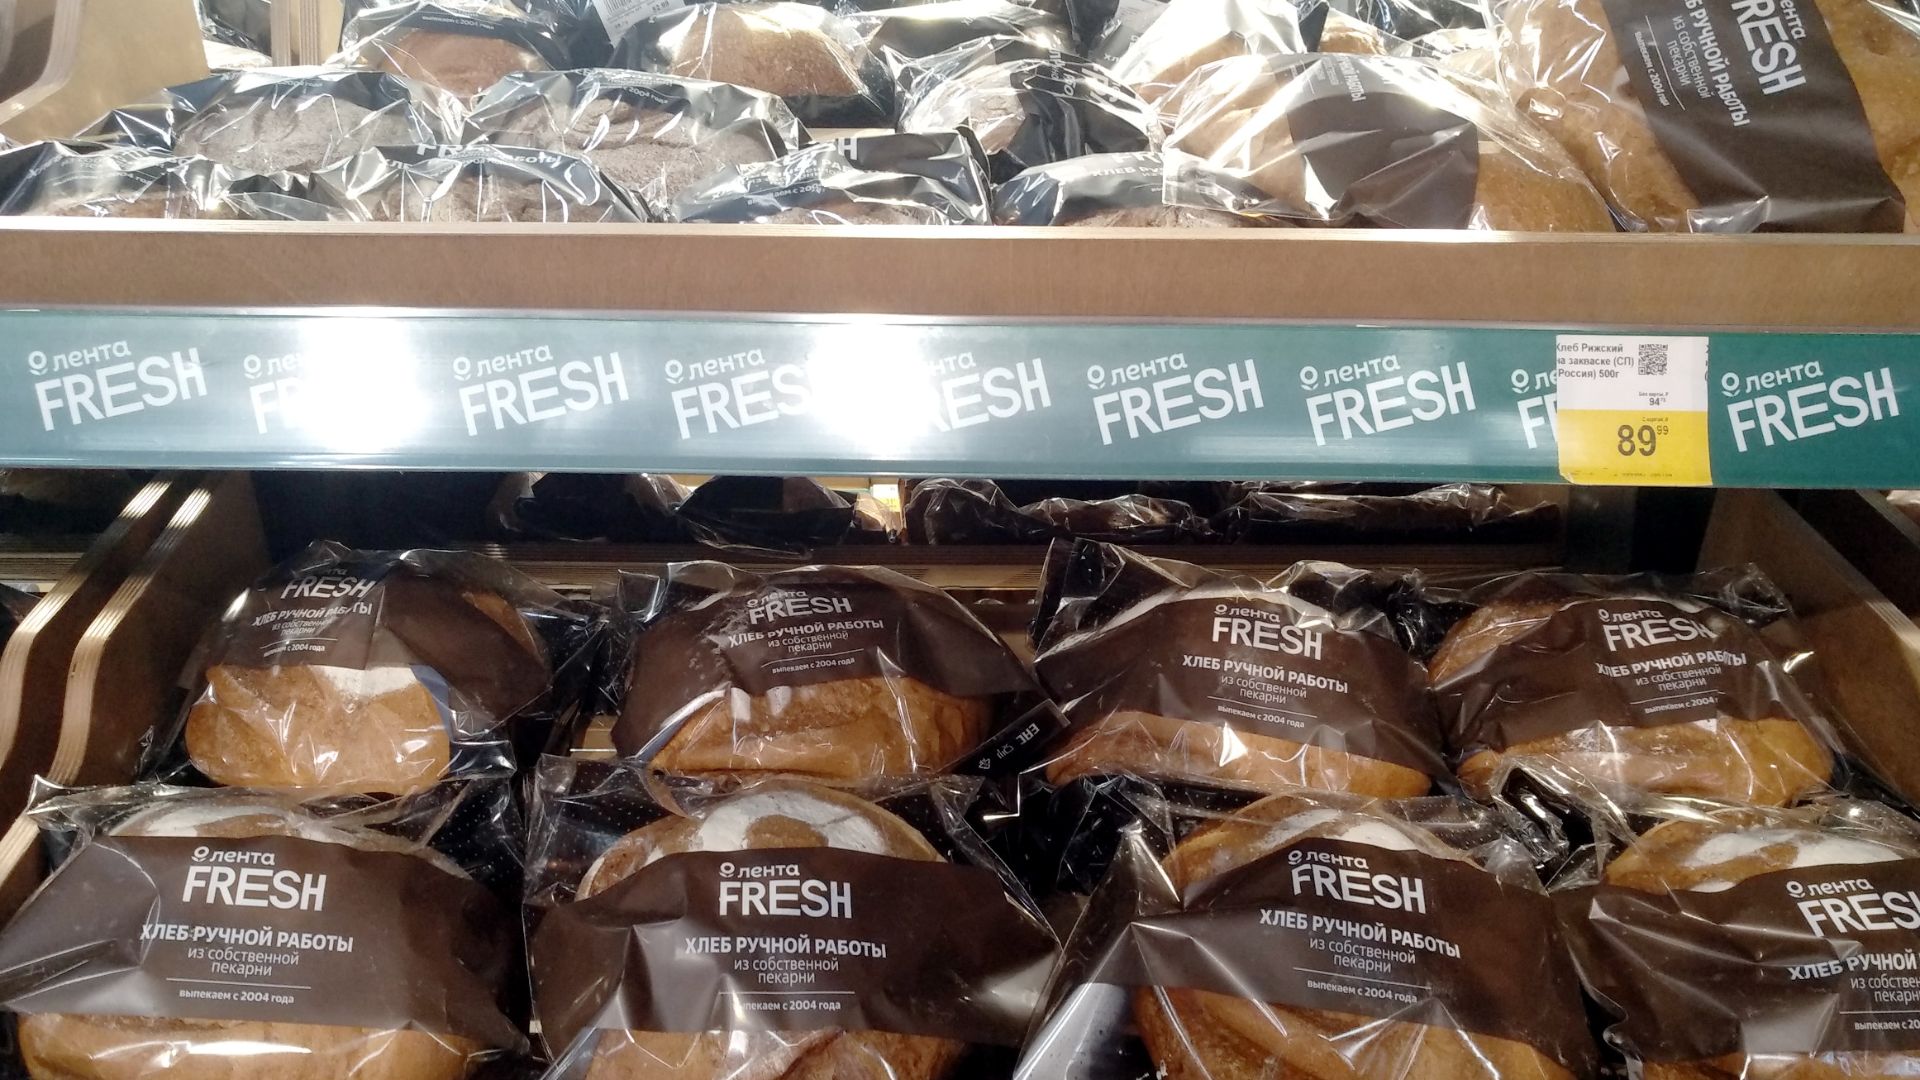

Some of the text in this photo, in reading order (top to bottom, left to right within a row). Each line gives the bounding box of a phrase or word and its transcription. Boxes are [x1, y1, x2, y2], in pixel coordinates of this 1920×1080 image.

[1672, 15, 1686, 31] из
[1780, 0, 1806, 40] ента
[1731, 0, 1806, 95] RESH
[1667, 40, 1692, 87] пекарни
[1678, 30, 1715, 99] собственной
[1690, 8, 1750, 127] РУЧНОЙ РАБОТЫ
[1650, 72, 1664, 95] 2004
[53, 339, 132, 371] лента
[1582, 343, 1623, 353] Рижский
[477, 344, 554, 377] лента
[687, 348, 766, 381] лента
[1112, 352, 1188, 386] лента
[1323, 354, 1401, 387] лента
[1568, 358, 1611, 366] закваске
[1613, 356, 1634, 367] (СП)
[1599, 369, 1619, 379] 500г
[1746, 361, 1823, 392] лента
[34, 347, 208, 431] FRESH
[458, 351, 630, 436] FRESH
[671, 361, 812, 440] FRES
[1093, 358, 1264, 445] FRESH
[1307, 361, 1476, 446] FRESH
[1649, 397, 1660, 406] 94
[1726, 367, 1900, 453] FRESH
[1617, 424, 1669, 456] 89 99
[280, 576, 376, 599] FRESH
[251, 611, 279, 626] ХЛЕБ
[277, 606, 326, 621] РУЧНОЙ
[749, 597, 852, 625] FRESH
[1229, 606, 1281, 623] лента
[1612, 609, 1664, 623] лента
[728, 619, 884, 648] ХЛЕБ РУЧНОЙ РАБОТЫ
[768, 631, 849, 648] из собственной
[1212, 617, 1323, 660] FRESH
[291, 644, 309, 652] 2004
[309, 644, 326, 653] года
[788, 641, 832, 653] пекарни
[772, 664, 809, 674] выпекаем
[816, 659, 837, 668] 2004
[838, 657, 855, 667] года
[1182, 654, 1349, 694] ХЛЕБ РУЧНОЙ РАБОТЫ
[1595, 662, 1630, 678] ХЛЕБ
[1631, 652, 1695, 674] РУЧНОЙ
[1636, 665, 1722, 686] из собственной
[1221, 675, 1307, 698] из собственной
[1239, 688, 1287, 704] пекарни
[1658, 677, 1707, 692] пекарни
[1692, 697, 1715, 707] 2004
[1217, 705, 1256, 720] выпекаем
[1263, 713, 1286, 725] 2004
[1286, 719, 1305, 729] года
[210, 850, 276, 866] лента
[1305, 849, 1369, 870] лента
[737, 863, 800, 878] лента
[182, 865, 327, 911] FRESH
[1291, 864, 1426, 914] FRESH
[1807, 878, 1874, 896] лента
[719, 879, 853, 919] FRESH
[140, 923, 354, 953] ХЛЕБ РУЧНОЙ РАБОТЫ
[1259, 908, 1461, 959] ХЛЕБ РУЧНОЙ РАБОТЫ
[187, 946, 300, 966] из собственной
[685, 934, 888, 959] ХЛЕБ РУЧНОЙ РАБОТЫ
[1309, 938, 1416, 965] из собственной
[211, 960, 273, 978] пекарни
[734, 956, 839, 971] из собственной
[1333, 954, 1392, 974] пекарни
[1788, 948, 1918, 981] ХЛЕБ РУЧНОЙ
[758, 971, 816, 987] пекарни
[1850, 977, 1866, 990] из
[179, 988, 232, 1001] выпекаем
[240, 991, 269, 1002] 2004
[270, 993, 295, 1004] года
[1307, 980, 1356, 995] выпекаем
[1364, 986, 1393, 1000] 2004
[1394, 992, 1418, 1004] года
[1874, 990, 1920, 1006] пекарн
[789, 1000, 817, 1011] 2004
[818, 1001, 841, 1012] года
[1854, 1021, 1900, 1031] выпекаем
[1908, 1019, 1920, 1029] 20
